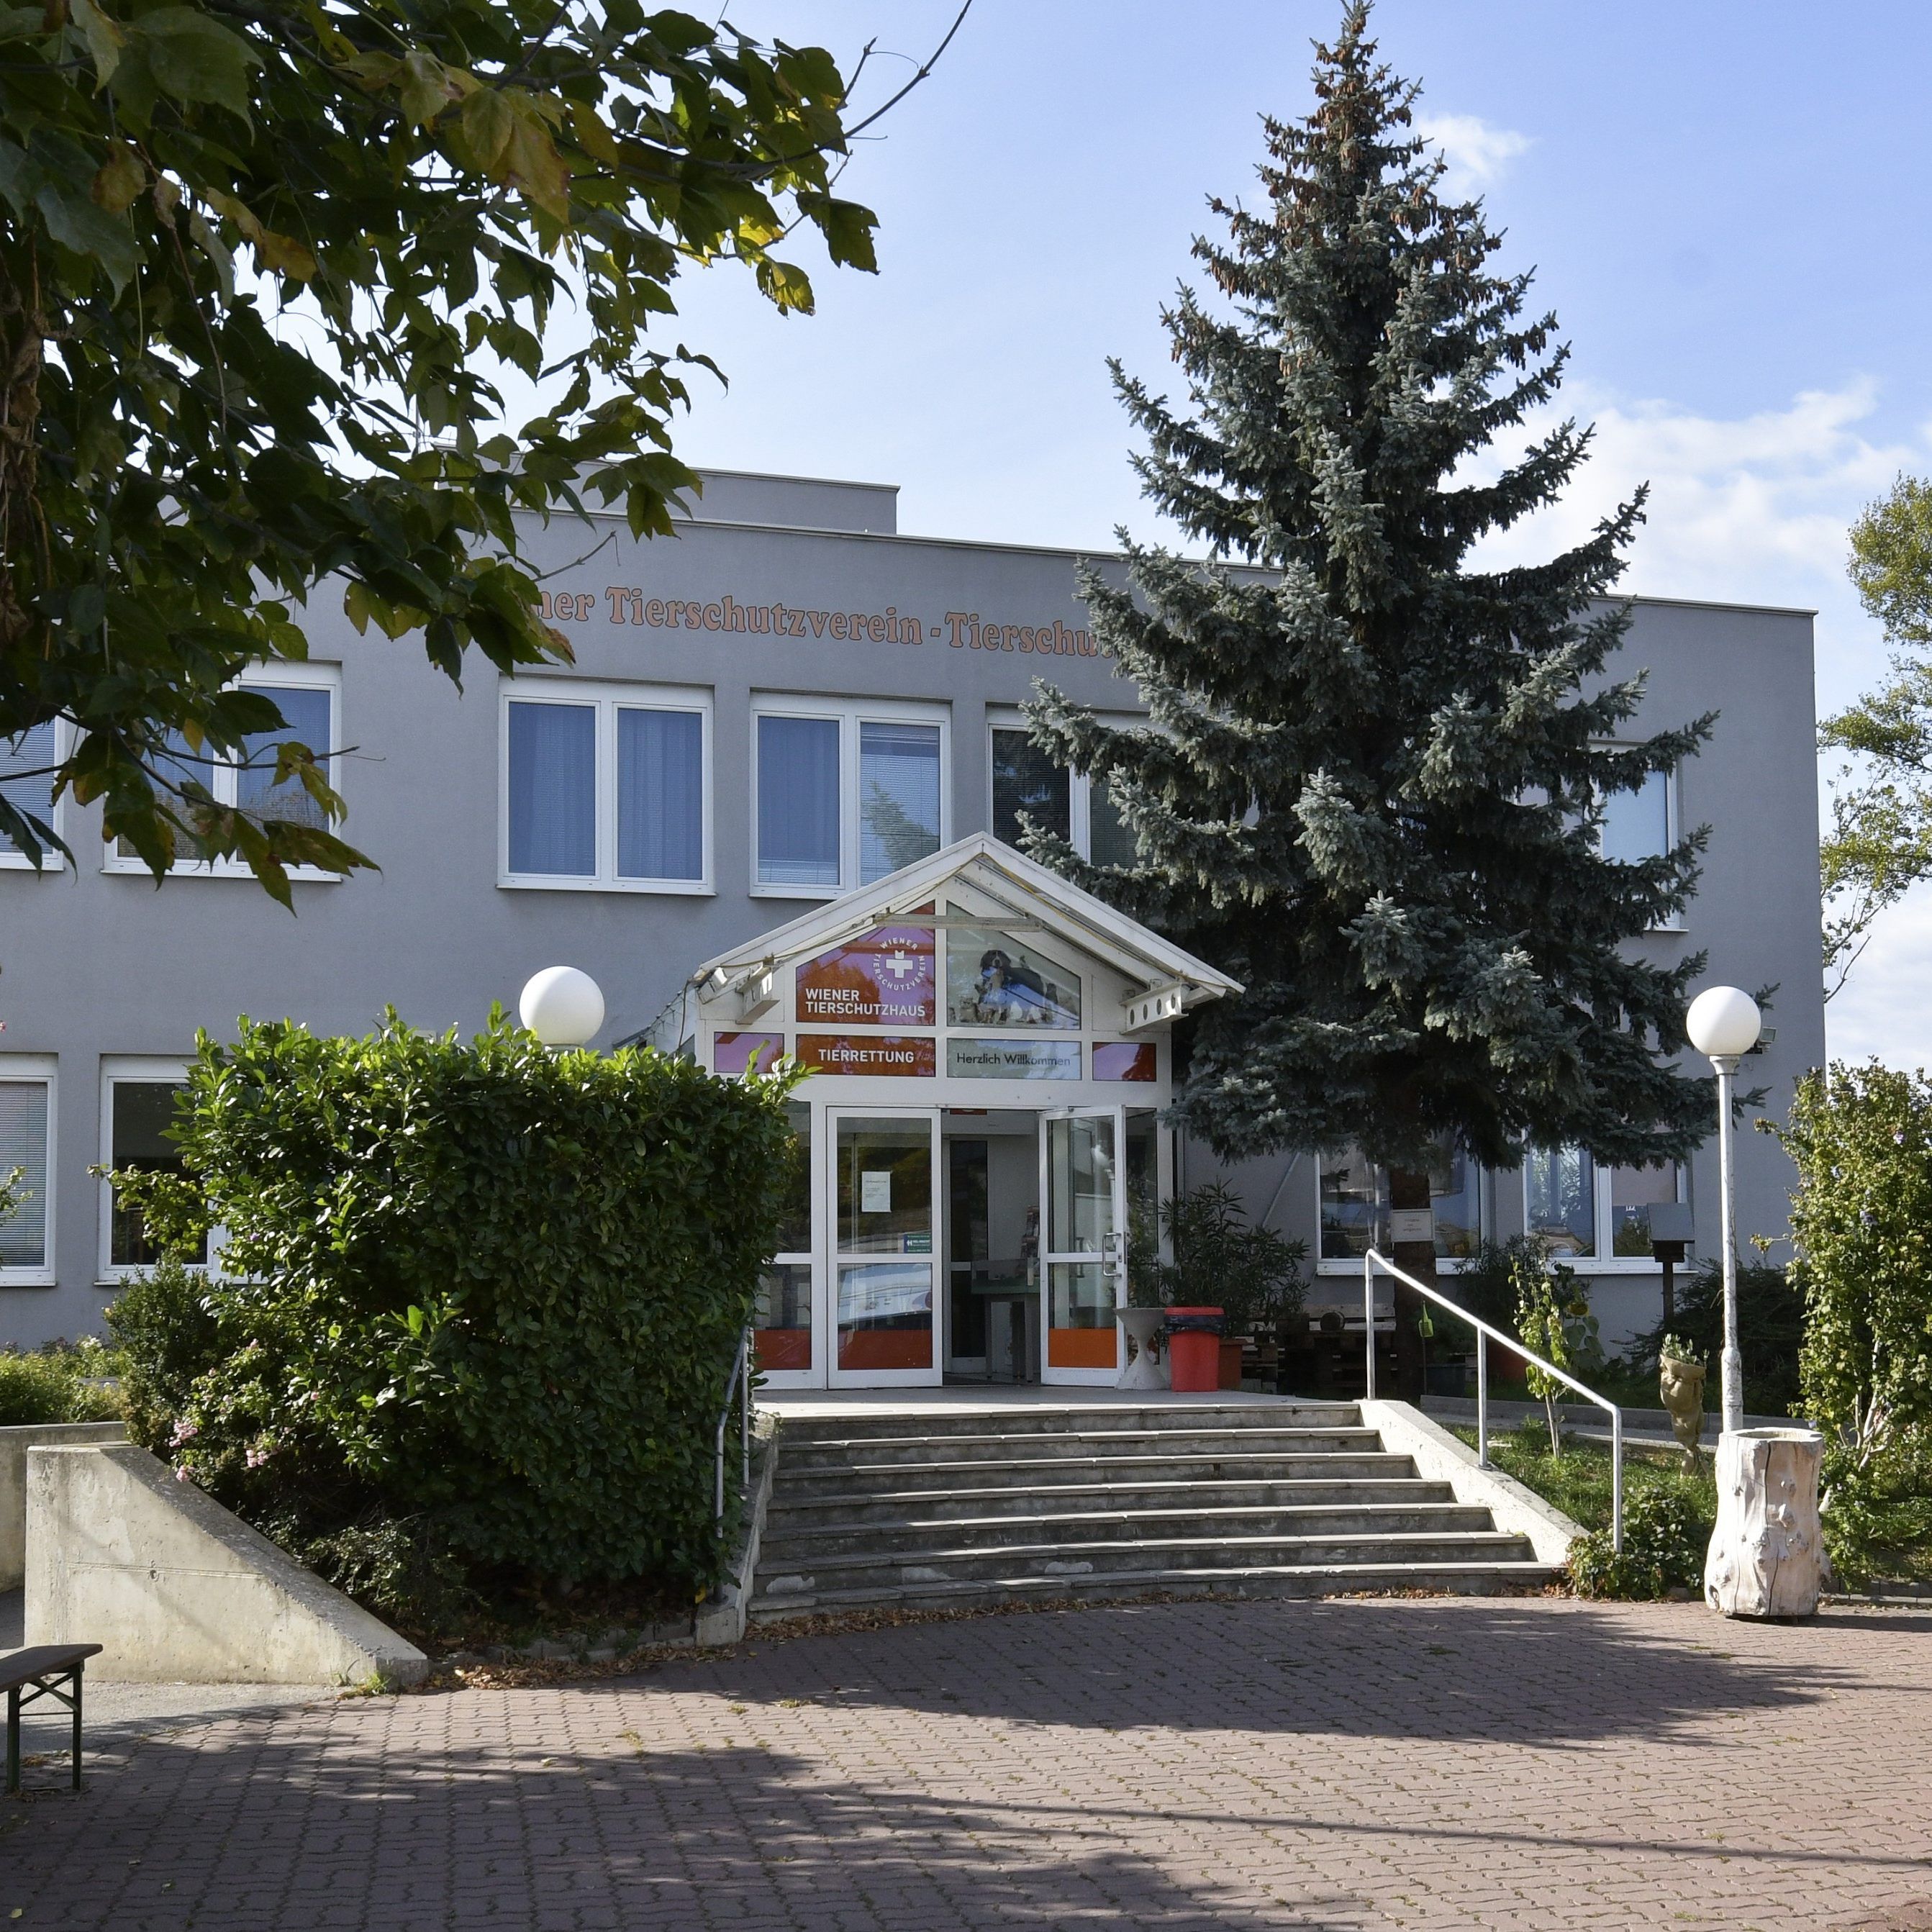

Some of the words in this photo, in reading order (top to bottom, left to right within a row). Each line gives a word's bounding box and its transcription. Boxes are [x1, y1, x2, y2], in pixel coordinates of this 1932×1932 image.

[531, 591, 595, 622] ner
[605, 586, 923, 645] Tierschutzverein
[879, 937, 918, 951] WIENER
[873, 953, 926, 991] TIERSCHUTZVEREIN
[805, 988, 860, 1001] WIENER
[805, 1001, 926, 1017] TIERSCHUTZHAUS
[818, 1048, 915, 1063] TIERRETTUNG
[956, 1053, 1001, 1065] Herzlich
[1004, 1053, 1071, 1066] Willkommen
